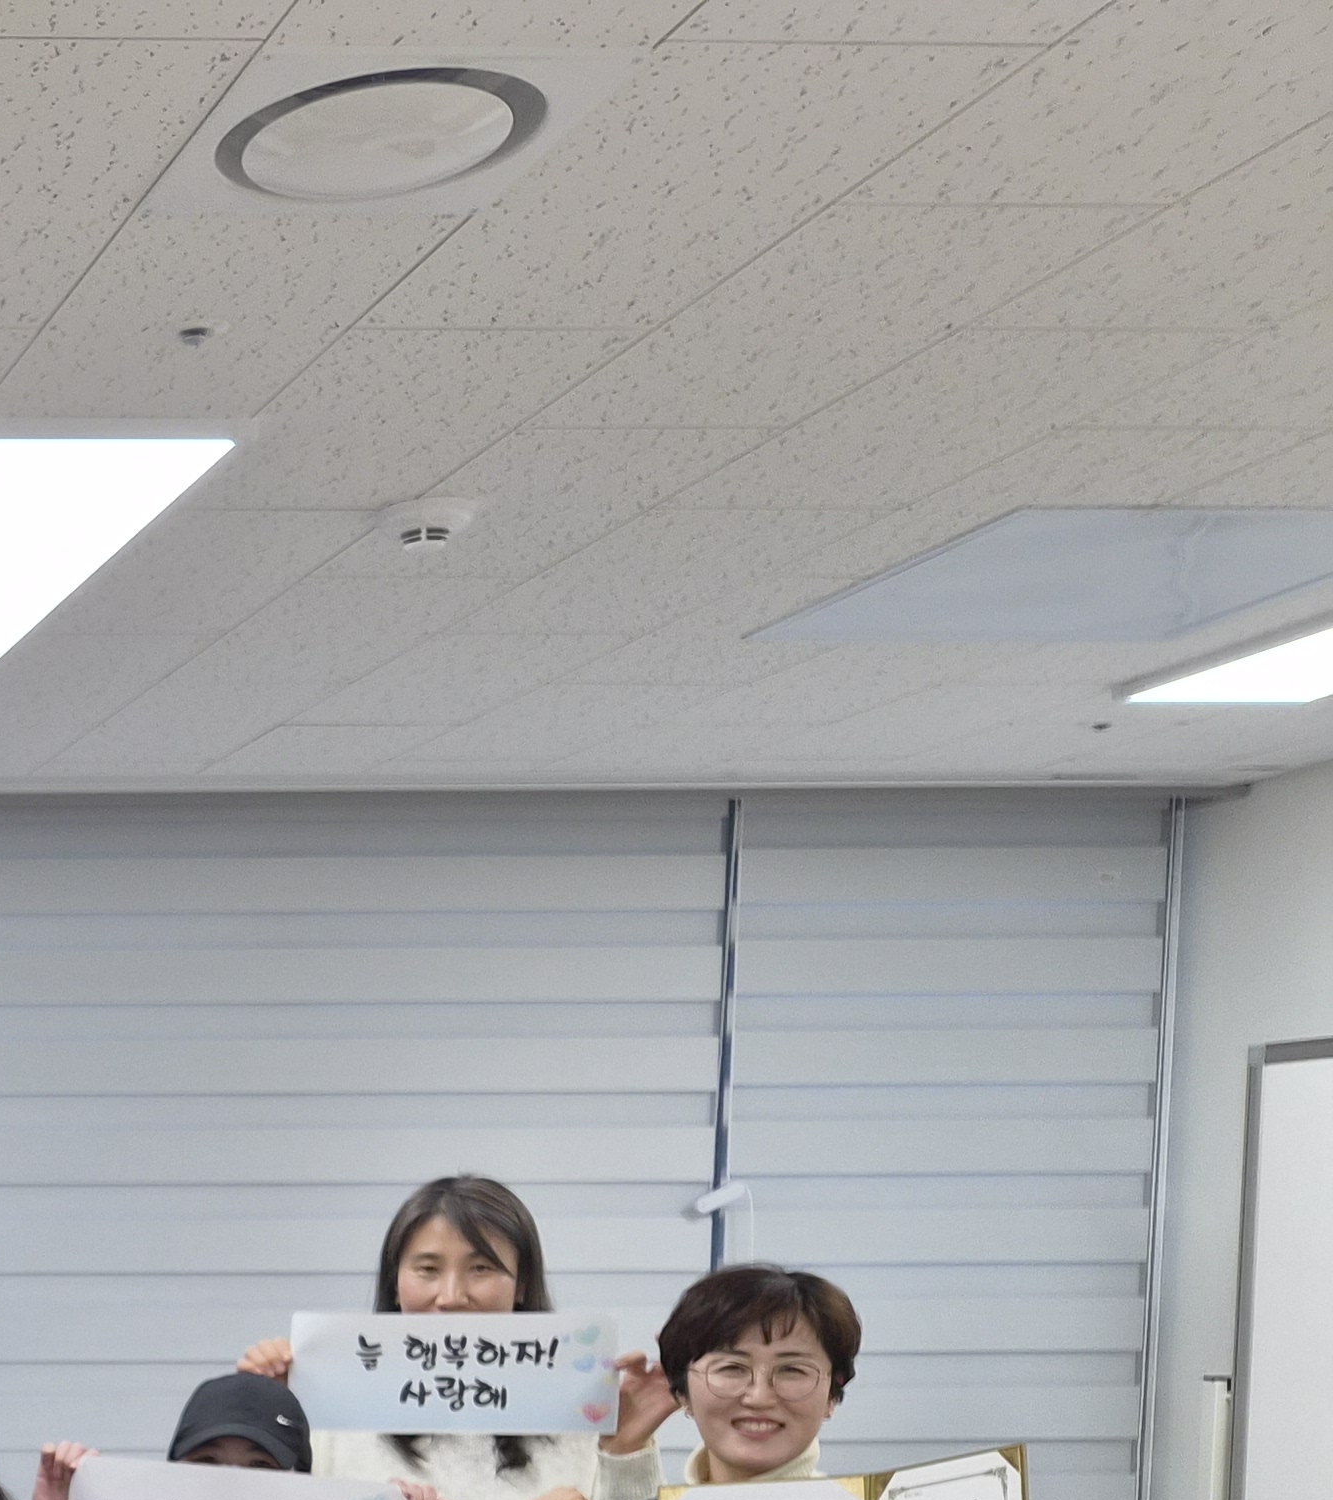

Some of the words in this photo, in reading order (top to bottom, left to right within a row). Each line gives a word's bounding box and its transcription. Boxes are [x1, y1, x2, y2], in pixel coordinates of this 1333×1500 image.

[356, 1334, 383, 1371] 늘
[403, 1334, 560, 1371] 행복하자!
[399, 1376, 508, 1412] 사랑해
